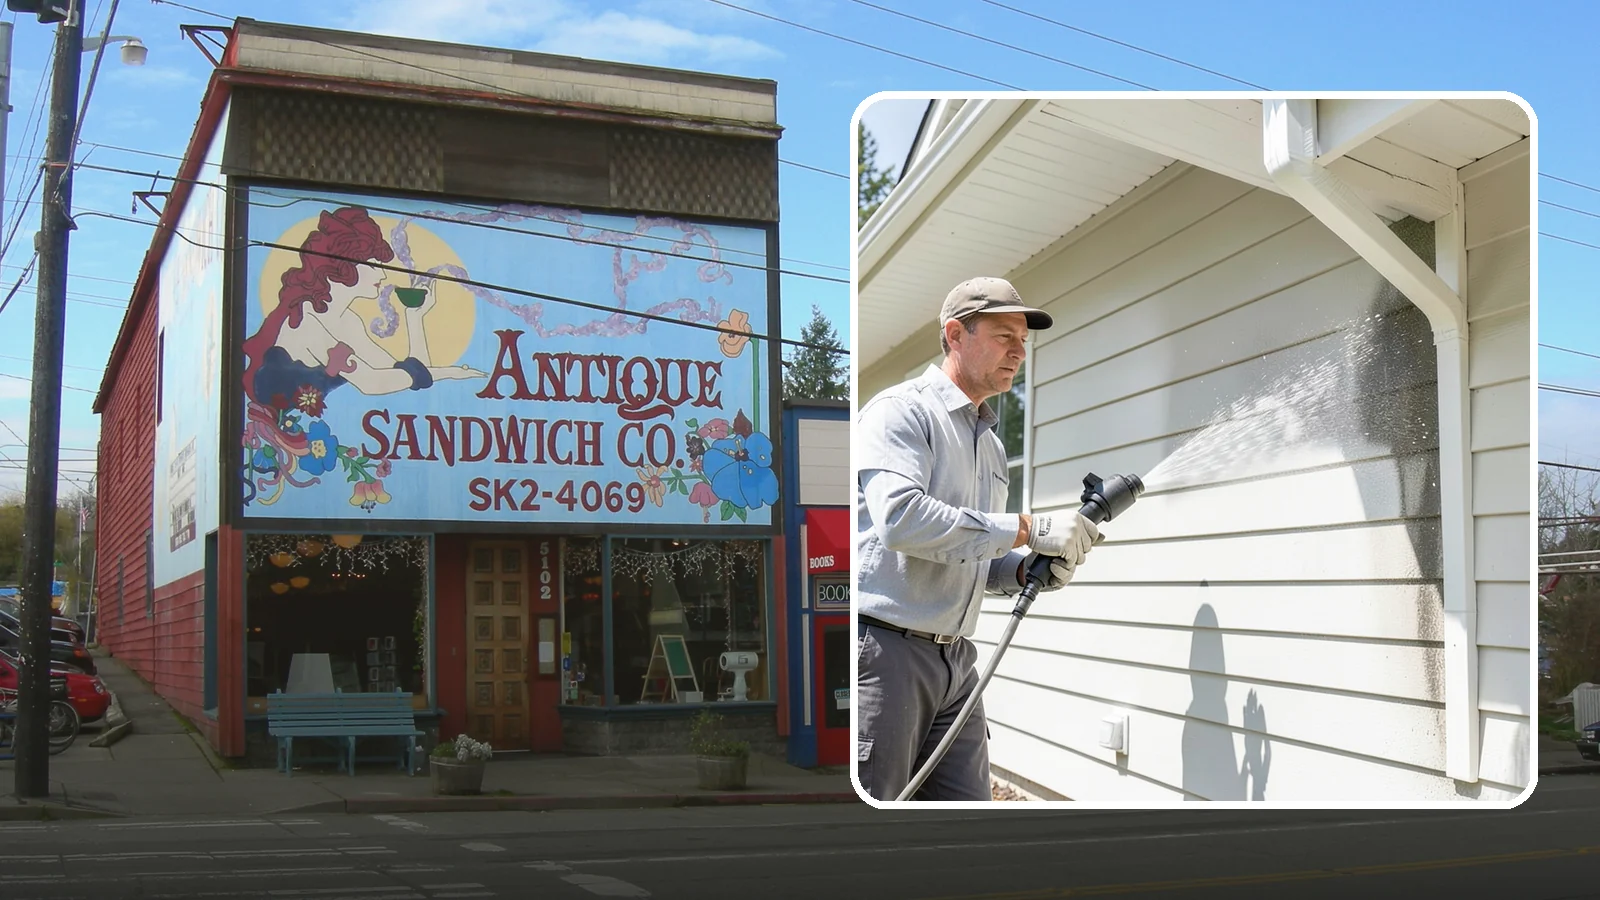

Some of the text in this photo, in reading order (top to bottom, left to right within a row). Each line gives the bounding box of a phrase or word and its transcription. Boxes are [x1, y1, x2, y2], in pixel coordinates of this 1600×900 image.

[476, 328, 723, 421] ANTIQUE
[361, 408, 686, 470] SANDWICH CO.
[468, 477, 645, 513] SK2-4069
[539, 541, 551, 600] 5102
[809, 555, 835, 569] BOOKS
